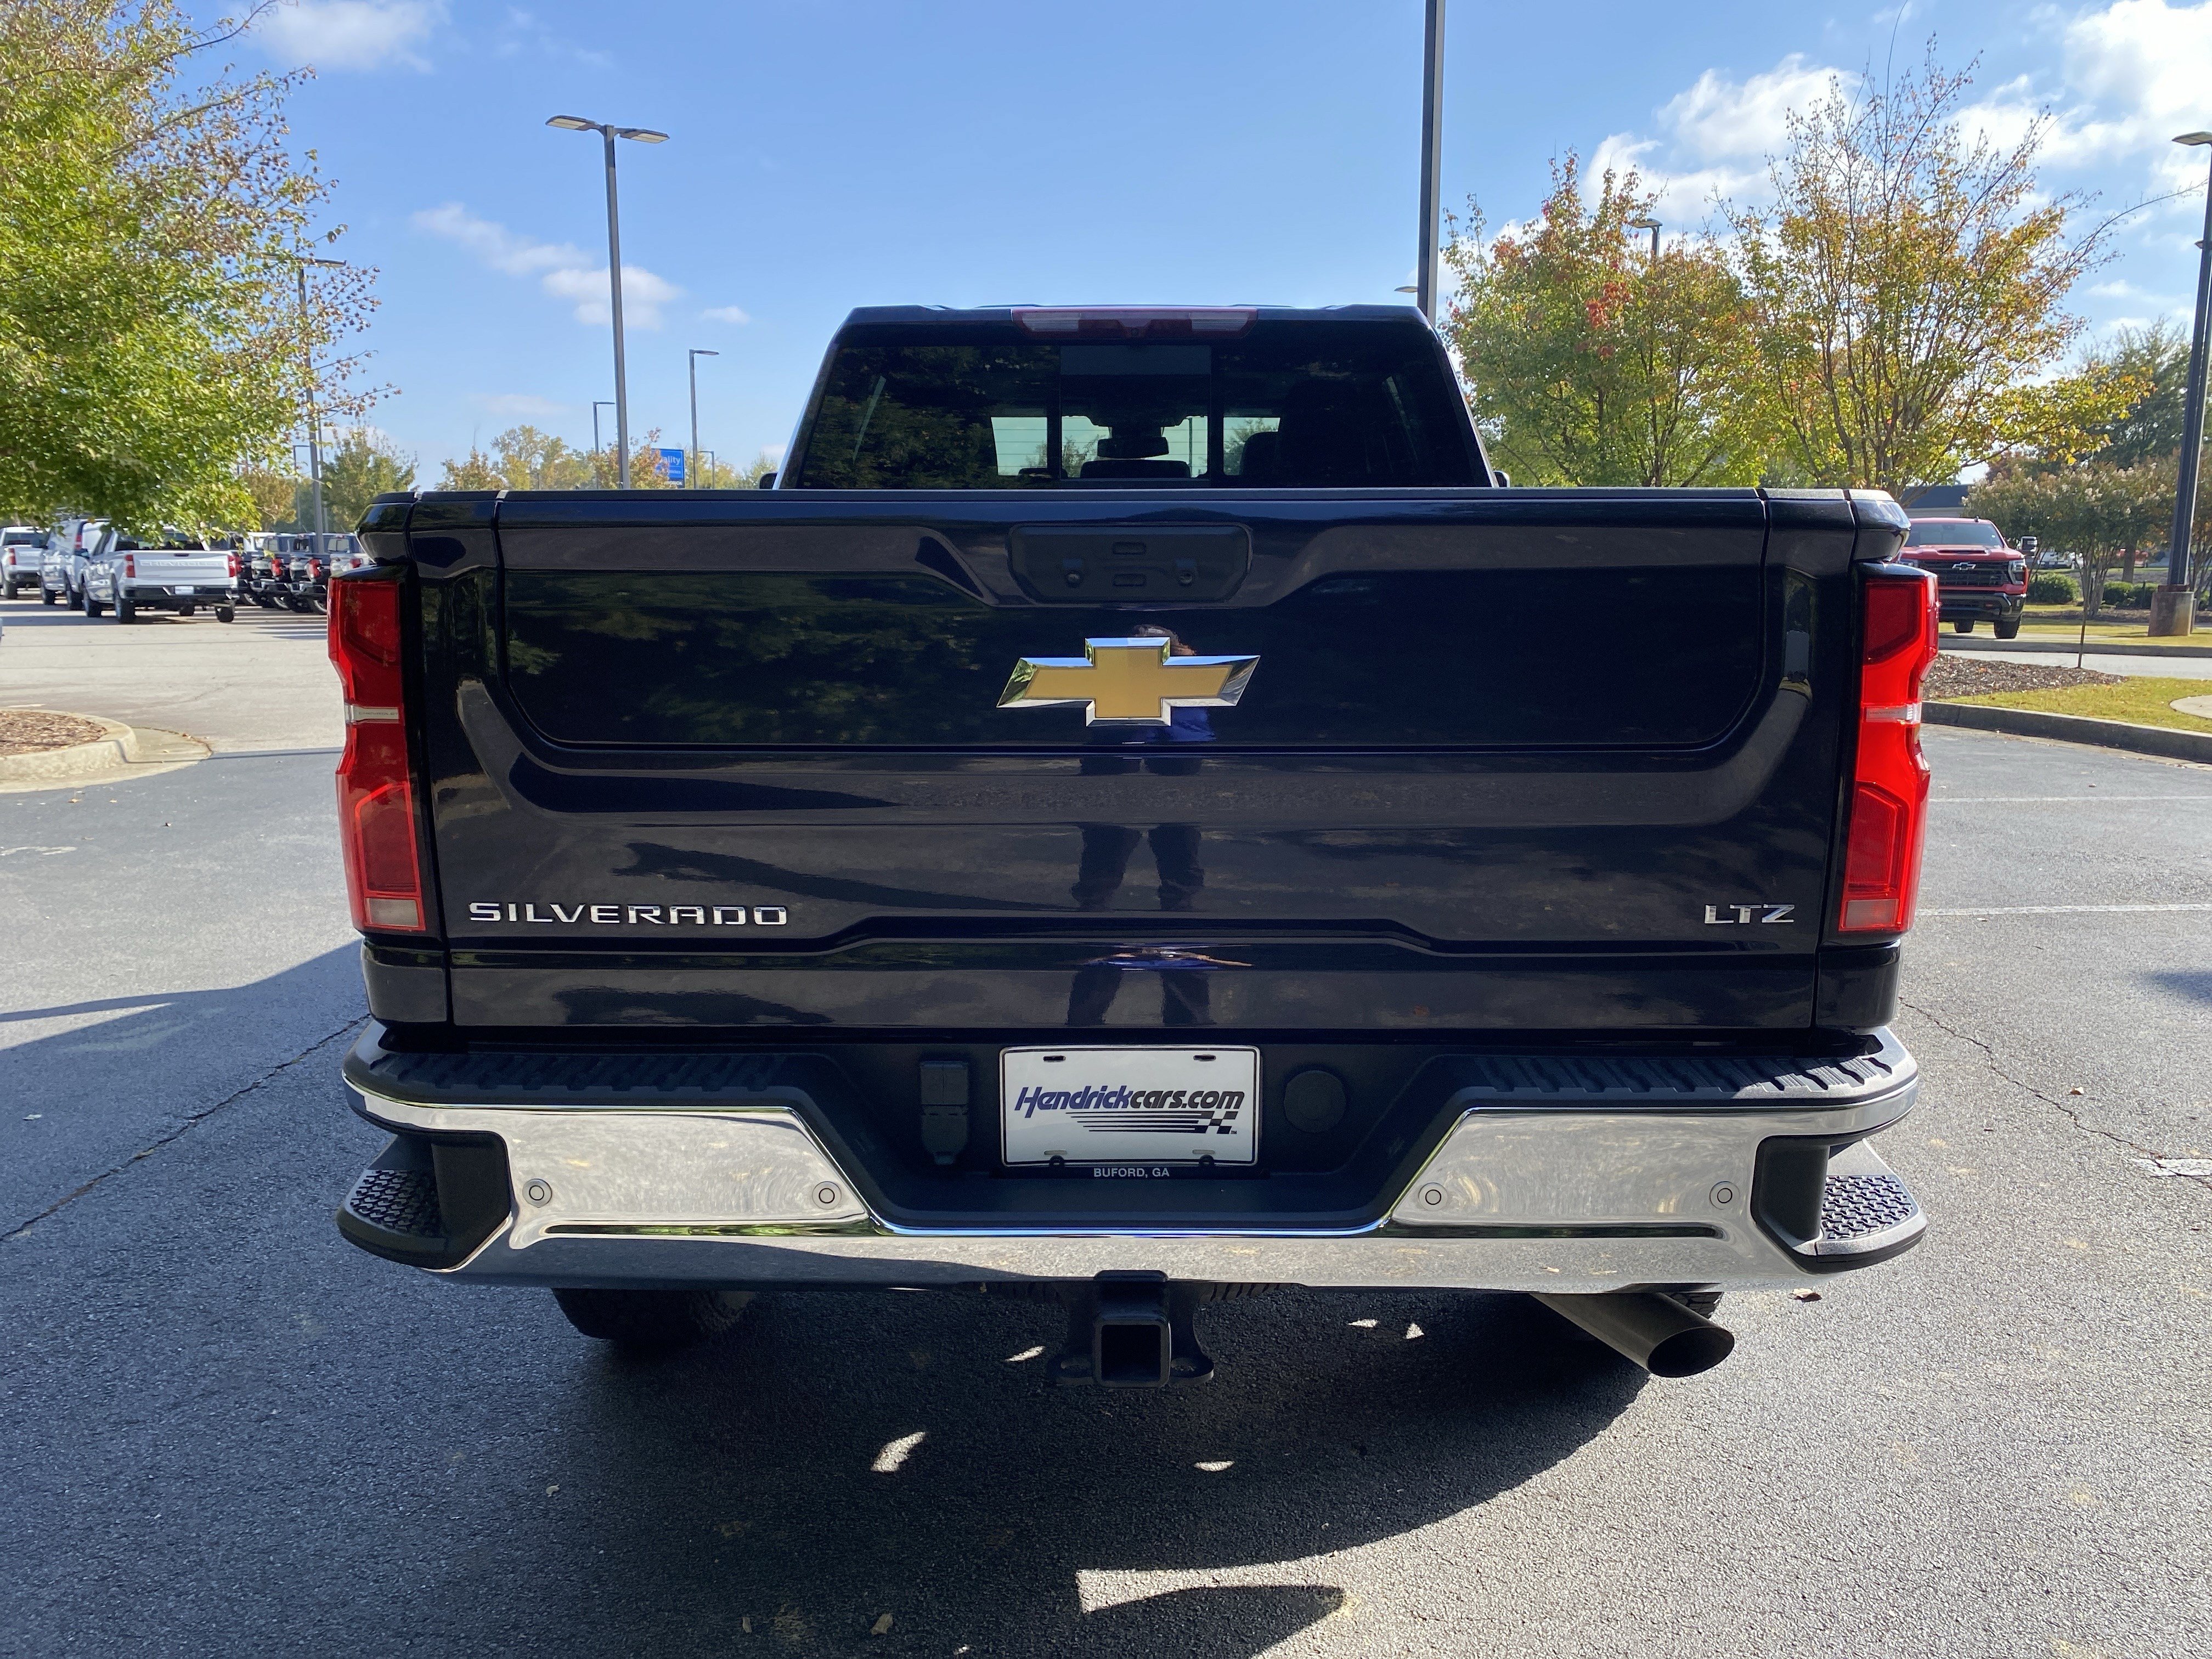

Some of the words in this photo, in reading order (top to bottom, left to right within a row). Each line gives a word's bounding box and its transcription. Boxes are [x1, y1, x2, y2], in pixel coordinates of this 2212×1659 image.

[662, 455, 681, 465] ality
[469, 902, 788, 926] SILVERADO
[1704, 904, 1795, 924] LTZ
[1014, 1085, 1245, 1119] Hendrickcars.com
[1093, 1167, 1149, 1179] BUFORD,
[1152, 1167, 1170, 1177] GA
